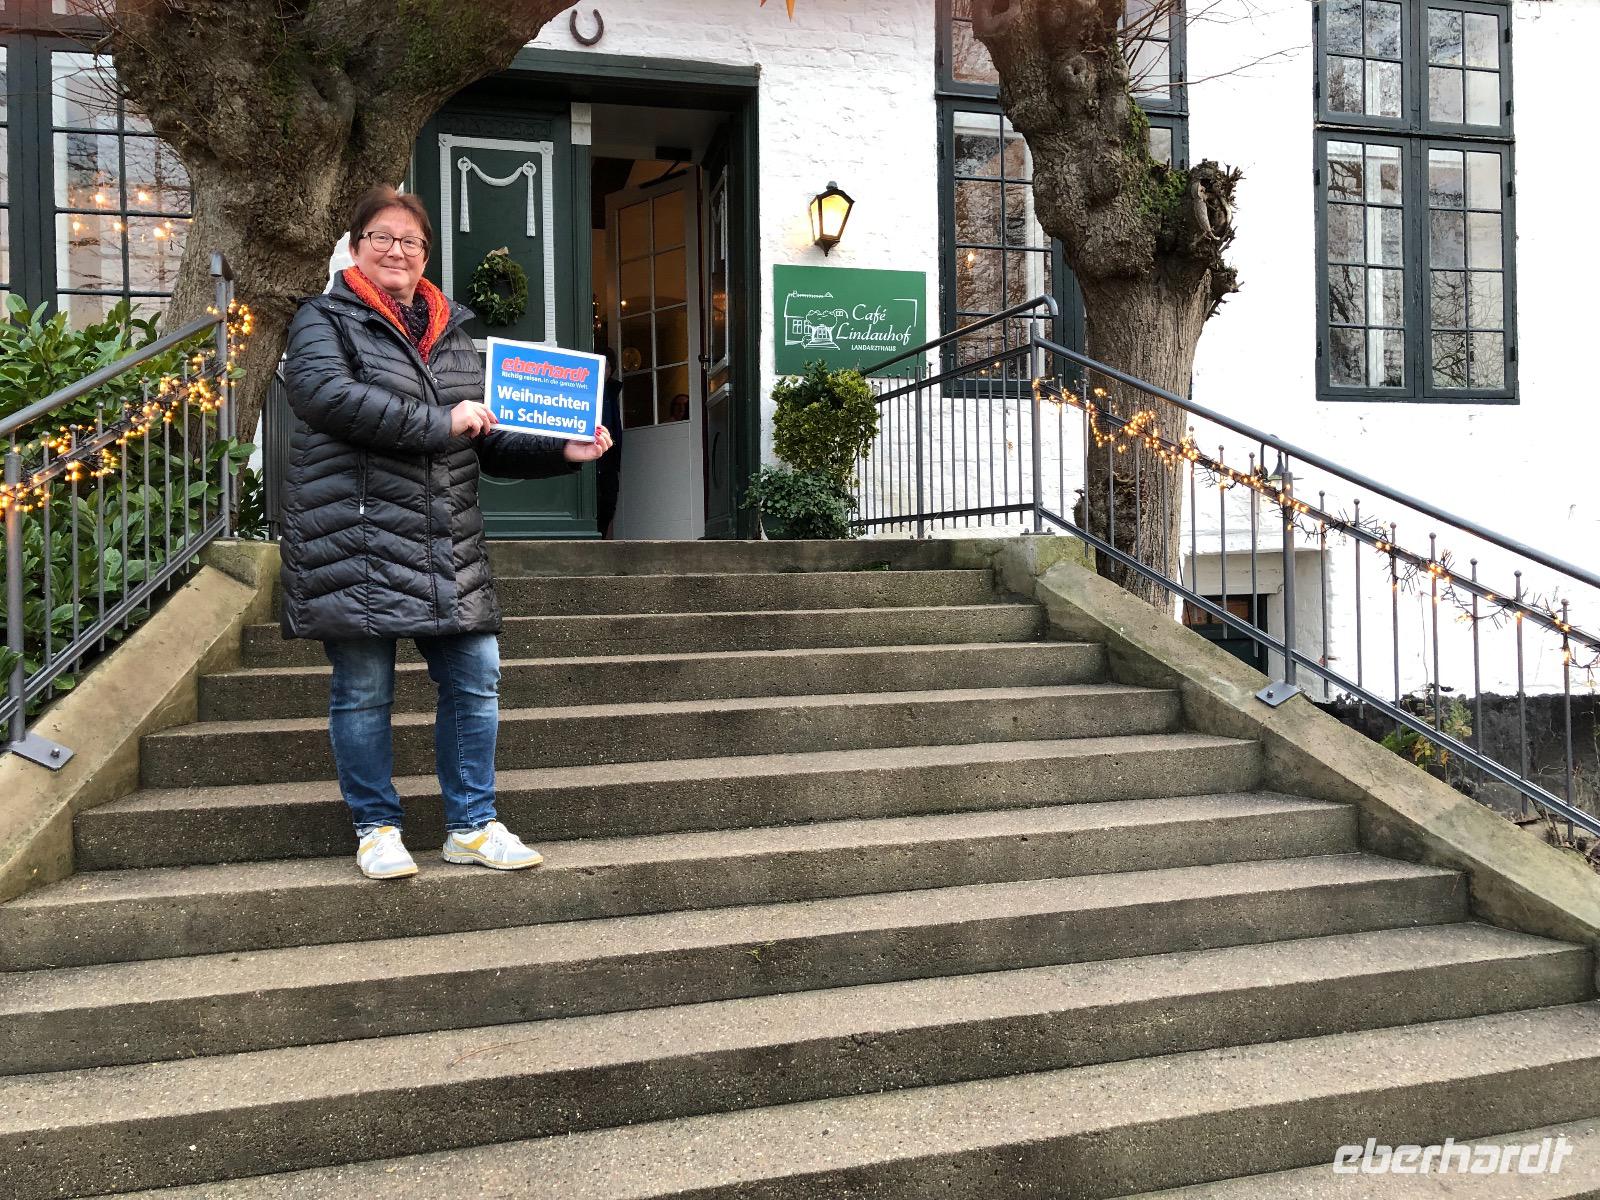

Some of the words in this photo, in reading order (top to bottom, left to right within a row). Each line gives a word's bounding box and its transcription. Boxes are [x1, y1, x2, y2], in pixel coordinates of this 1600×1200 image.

[852, 303, 887, 325] Café
[835, 322, 912, 346] Lindauhof
[851, 344, 897, 352] LANDARZTHAUS
[501, 356, 590, 383] eberhardt
[501, 370, 523, 380] Richtig
[523, 374, 543, 383] reisen.
[497, 384, 590, 412] Weihnachten
[500, 405, 514, 420] in
[517, 408, 587, 433] Schleswig
